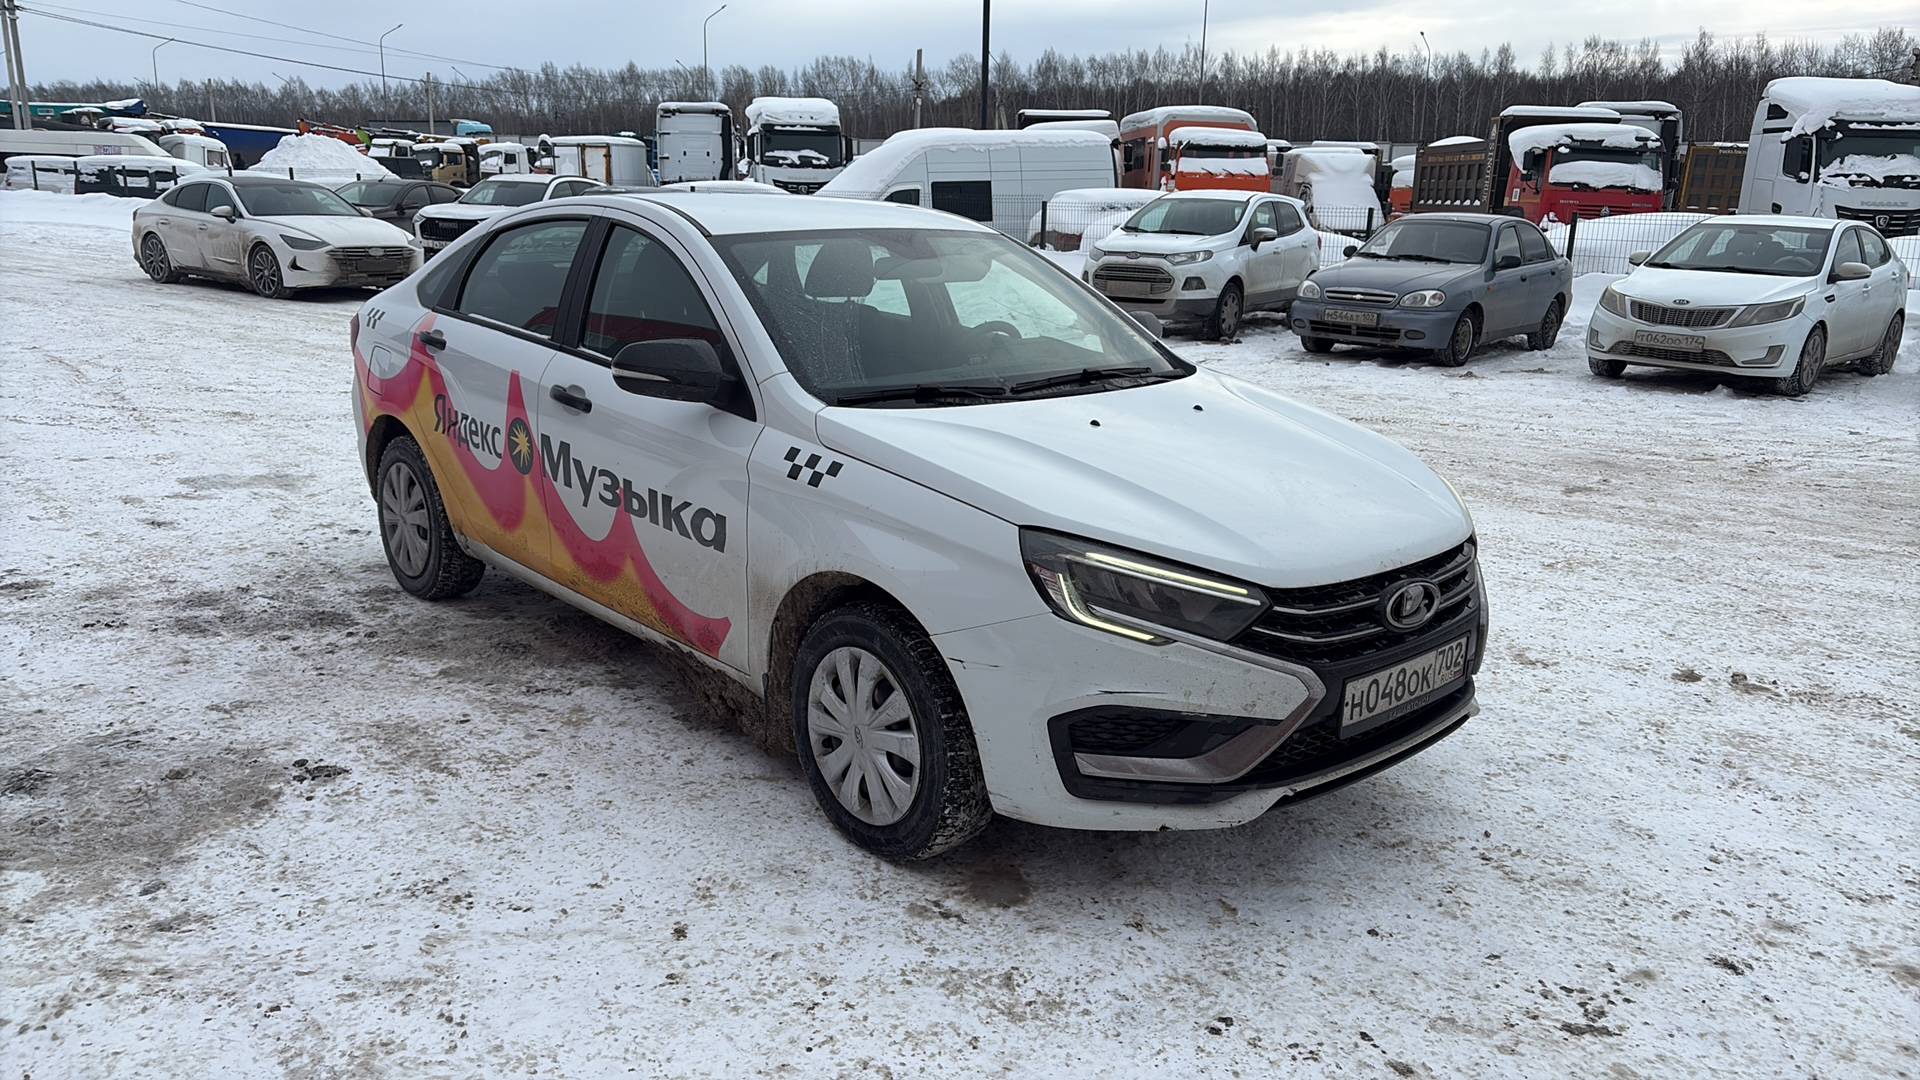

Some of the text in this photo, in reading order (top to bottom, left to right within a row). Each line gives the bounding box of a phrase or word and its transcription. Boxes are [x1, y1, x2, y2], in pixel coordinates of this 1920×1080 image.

[433, 393, 727, 553] Яндекс Музыка
[1437, 641, 1464, 676] 702
